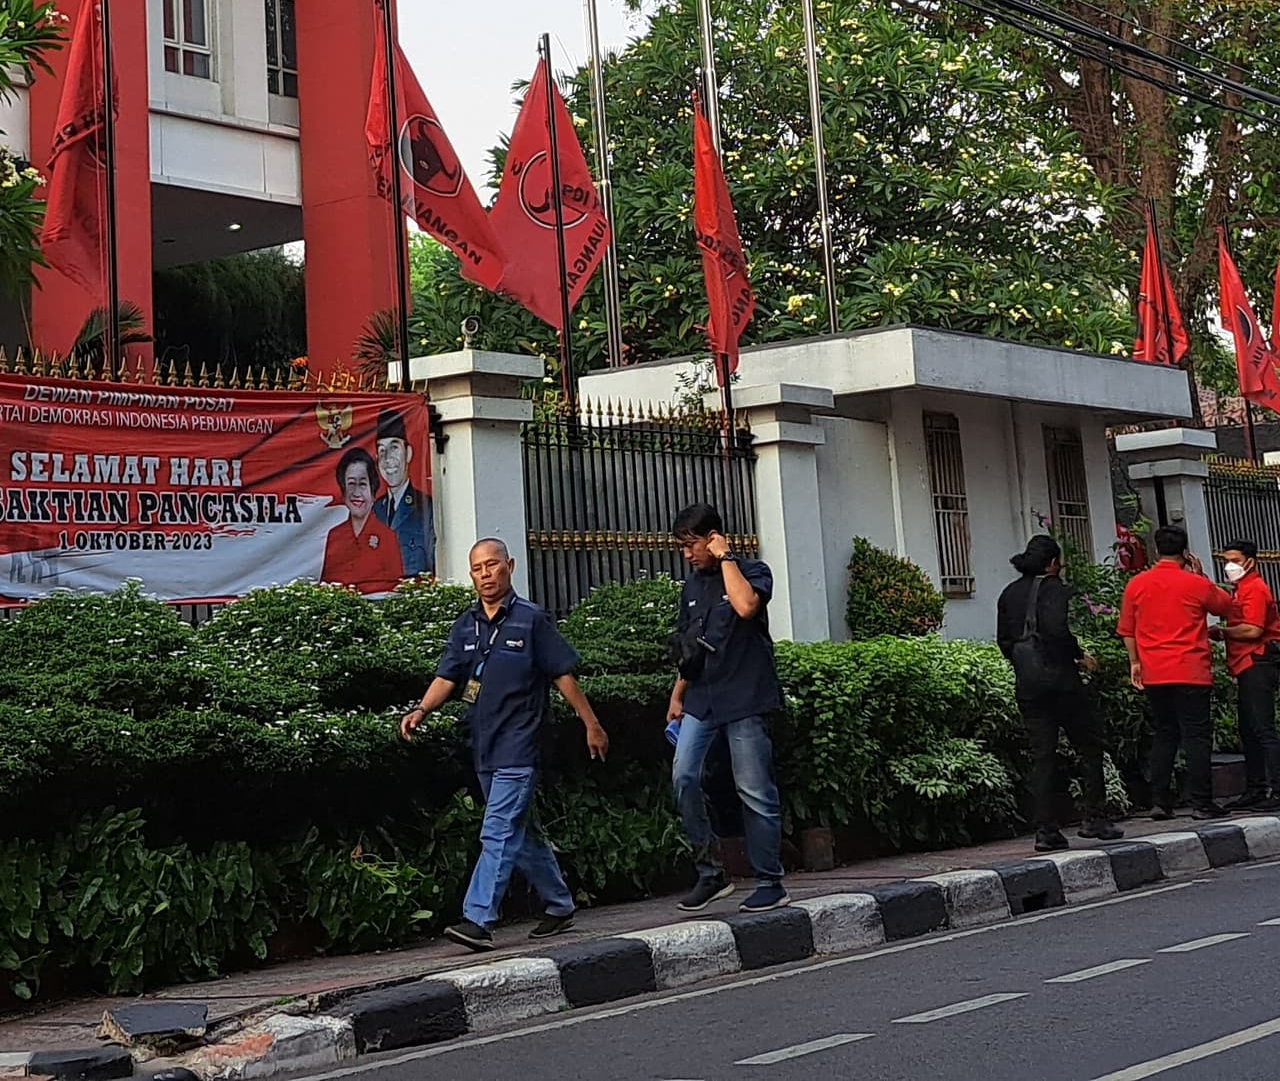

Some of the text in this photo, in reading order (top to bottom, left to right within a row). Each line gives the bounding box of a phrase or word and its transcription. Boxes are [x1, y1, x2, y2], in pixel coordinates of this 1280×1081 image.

[24, 384, 236, 413] DEWAN PIMPINAN PUSAT
[29, 406, 113, 427] DEMOKRASI
[116, 412, 189, 431] INDONESIA
[192, 416, 273, 434] PERJUANGAN
[11, 451, 243, 487] SELAMAT HARI
[138, 491, 303, 525] PANCASILA
[60, 532, 213, 551] 1 OKTOBER 2023
